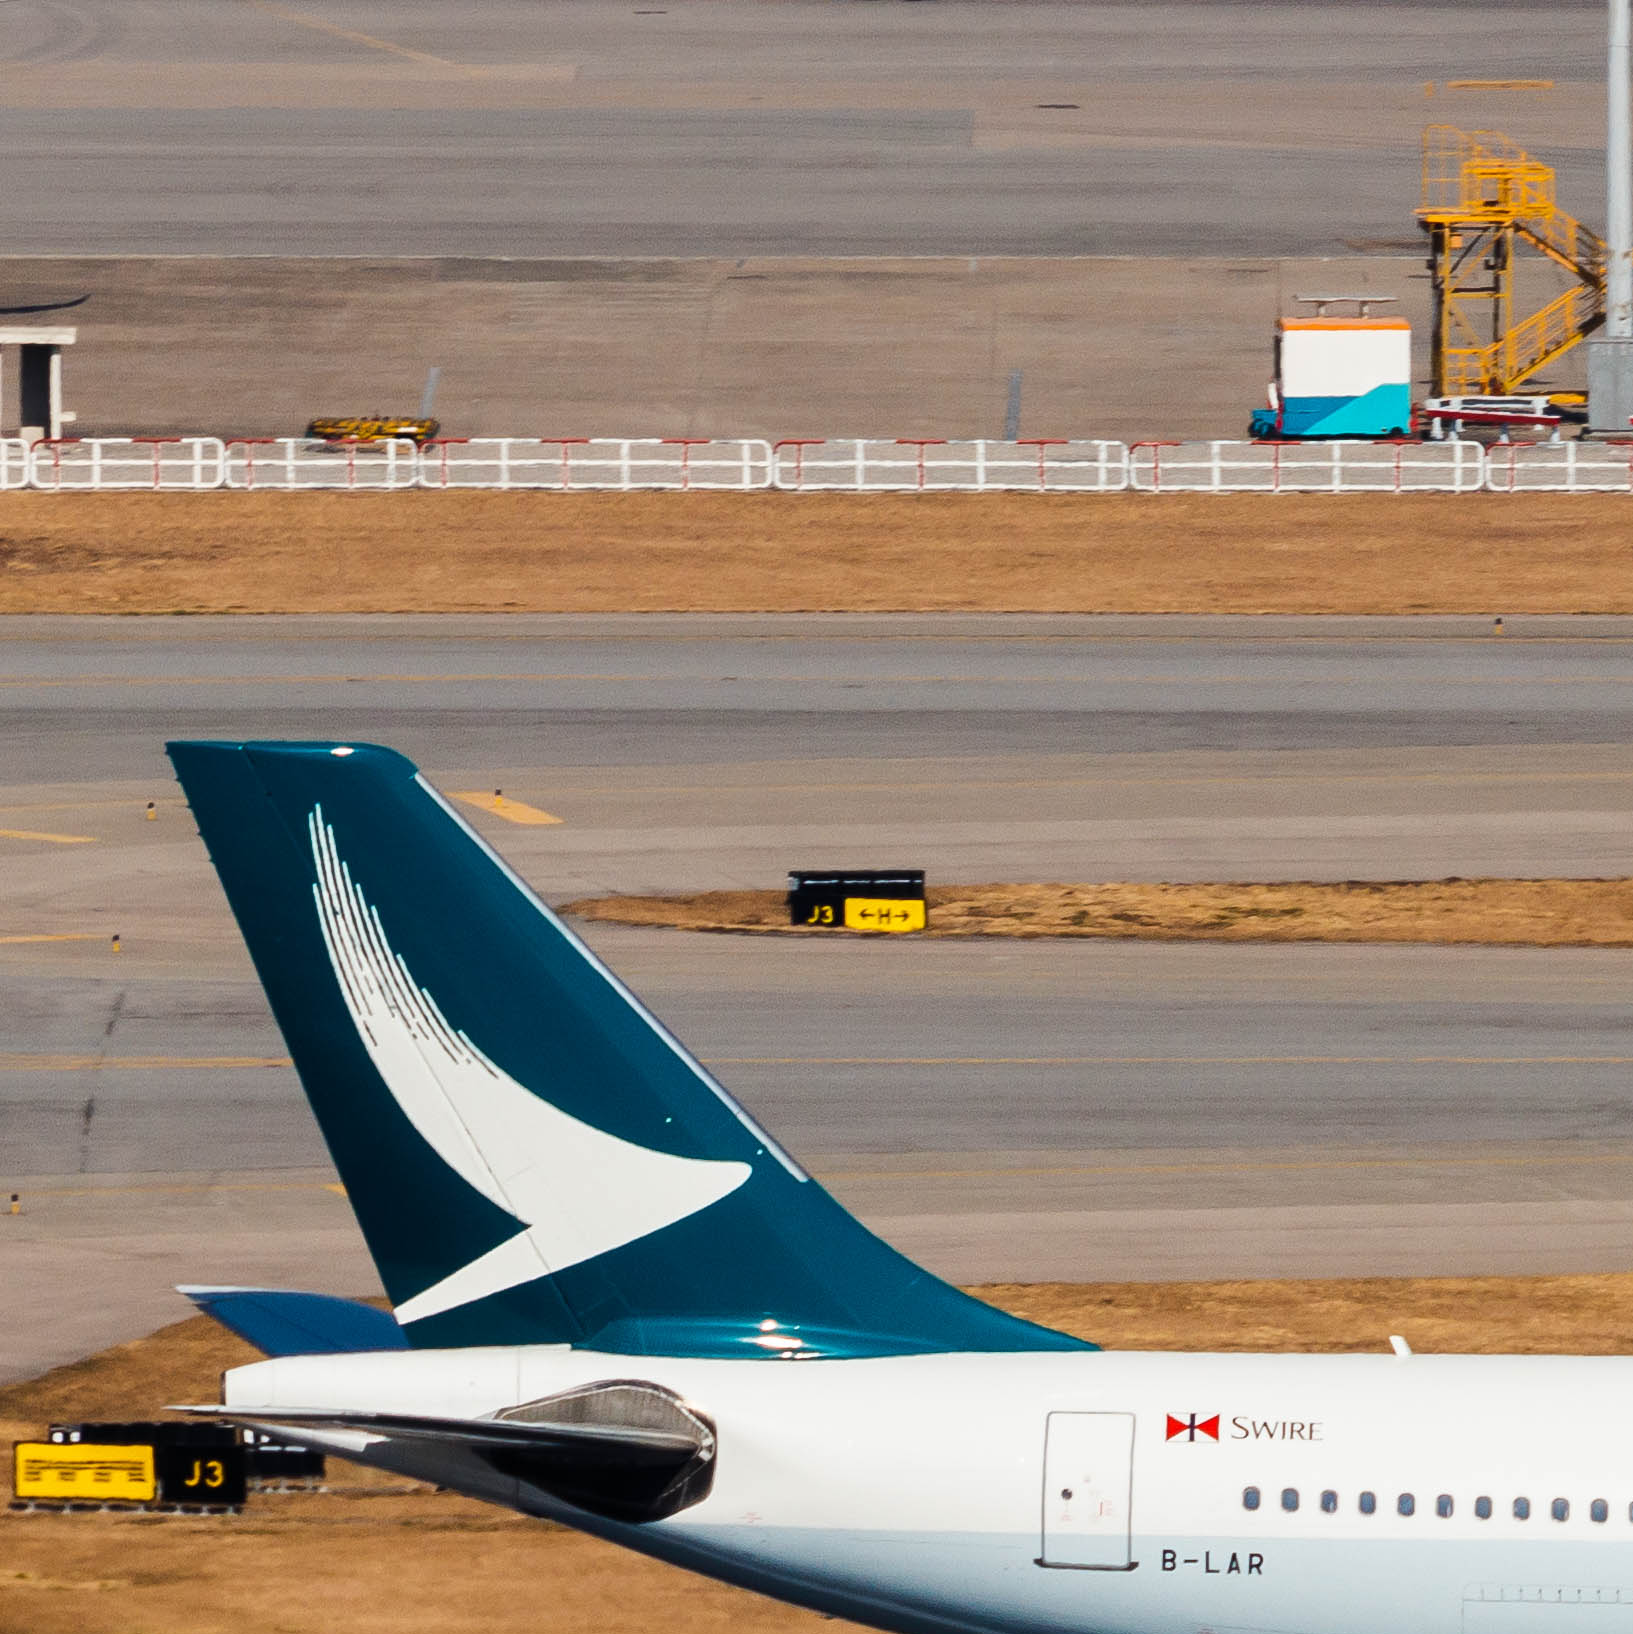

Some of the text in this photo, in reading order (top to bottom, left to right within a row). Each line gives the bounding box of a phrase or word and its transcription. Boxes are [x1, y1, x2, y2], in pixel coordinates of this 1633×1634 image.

[807, 905, 891, 924] J3 H
[185, 1460, 225, 1488] J3
[1161, 1549, 1264, 1575] B-LAR
